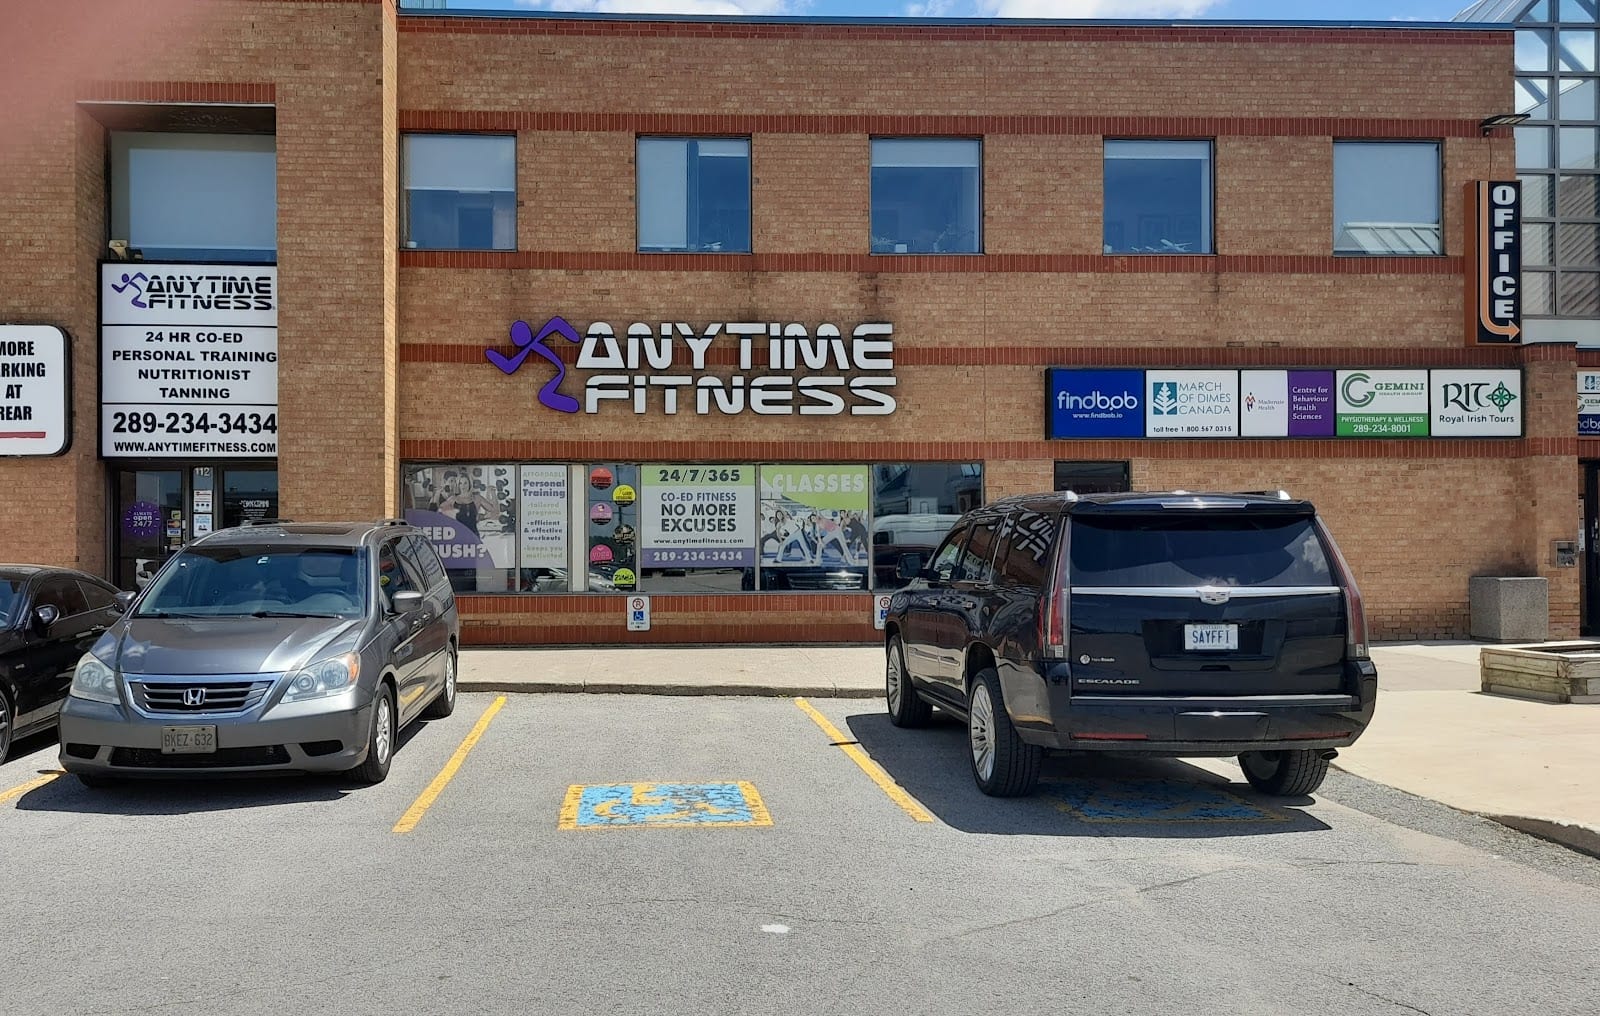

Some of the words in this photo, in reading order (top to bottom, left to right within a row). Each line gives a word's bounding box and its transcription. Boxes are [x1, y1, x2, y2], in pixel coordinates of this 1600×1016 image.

[1492, 185, 1516, 319] OFFICE
[146, 275, 272, 294] ANYTIME
[148, 295, 273, 310] FITNESS
[145, 332, 164, 343] 24
[169, 332, 191, 343] HR
[196, 332, 243, 343] CO-ED
[576, 321, 894, 370] ANYTIME
[112, 350, 195, 361] PERSONAL
[200, 351, 277, 363] TRAINING
[0, 363, 46, 377] RKING
[138, 369, 251, 380] NUTRITIONIST
[5, 384, 23, 399] AT
[1179, 382, 1222, 391] MARCH
[1292, 386, 1316, 394] Centre
[1318, 386, 1328, 394] for
[1374, 383, 1425, 391] GEMINI
[159, 387, 230, 399] TANNING
[585, 375, 897, 415] FITNESS
[1179, 393, 1194, 403] OF
[1198, 393, 1231, 403] DIMES
[1057, 391, 1138, 411] findbob
[1292, 395, 1328, 403] Behaviour
[1179, 405, 1231, 415] CANADA
[1292, 412, 1322, 420] Sciences
[1439, 415, 1465, 424] Royal
[1467, 415, 1487, 423] Irish
[1489, 415, 1515, 423] Tours
[112, 411, 277, 434] 289-234-3434
[1353, 424, 1411, 433] 289-234-8001
[114, 441, 276, 453] WWW.ANYTIMEFITNESS.COM
[194, 467, 211, 477] 112
[659, 468, 740, 483] 24/7/365
[523, 479, 565, 487] Personal
[772, 474, 865, 493] CLASSES
[522, 488, 566, 499] Training
[661, 492, 694, 502] CO-ED
[697, 492, 737, 502] FITNESS
[661, 503, 687, 516] NO
[691, 503, 736, 516] MORE
[661, 518, 737, 532] EXCUSES
[422, 526, 456, 540] EED
[653, 537, 744, 545] www.anytimefitness.com
[653, 551, 743, 561] 289-234-3434
